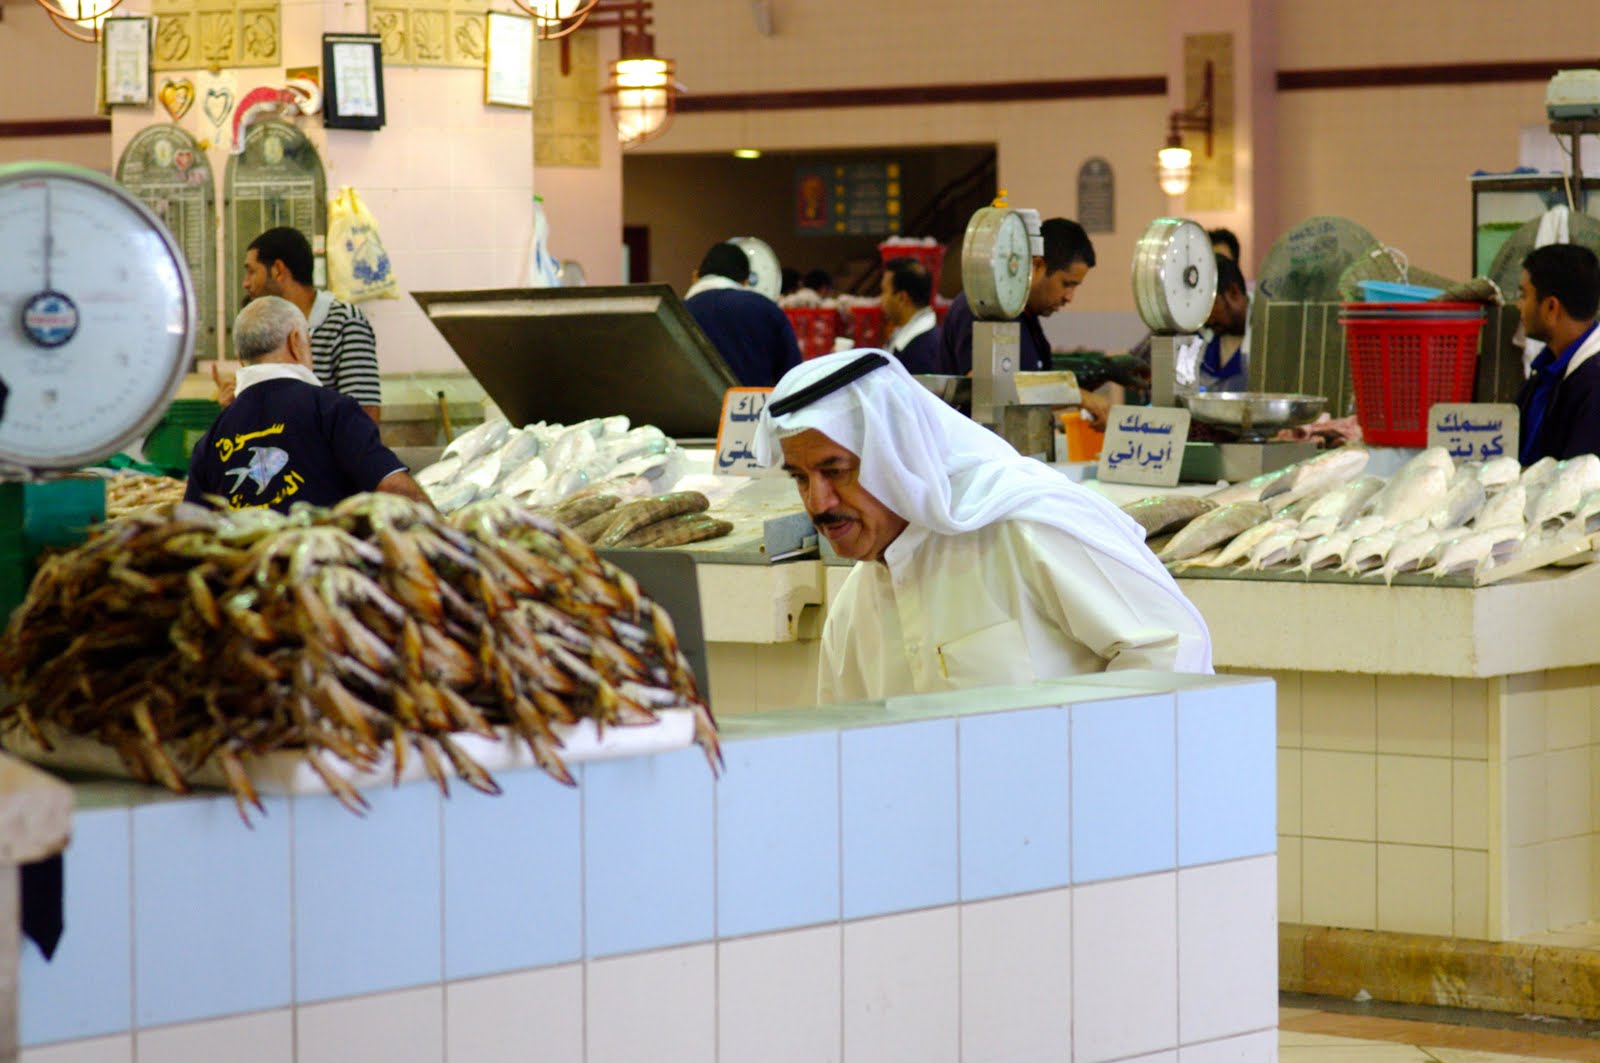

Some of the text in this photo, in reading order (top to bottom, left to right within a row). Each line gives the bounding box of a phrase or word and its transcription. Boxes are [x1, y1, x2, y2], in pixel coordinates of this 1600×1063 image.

[1118, 414, 1173, 435] سمك
[1436, 412, 1503, 432] سمك
[215, 422, 286, 463] سوق
[1449, 434, 1504, 464] كويت
